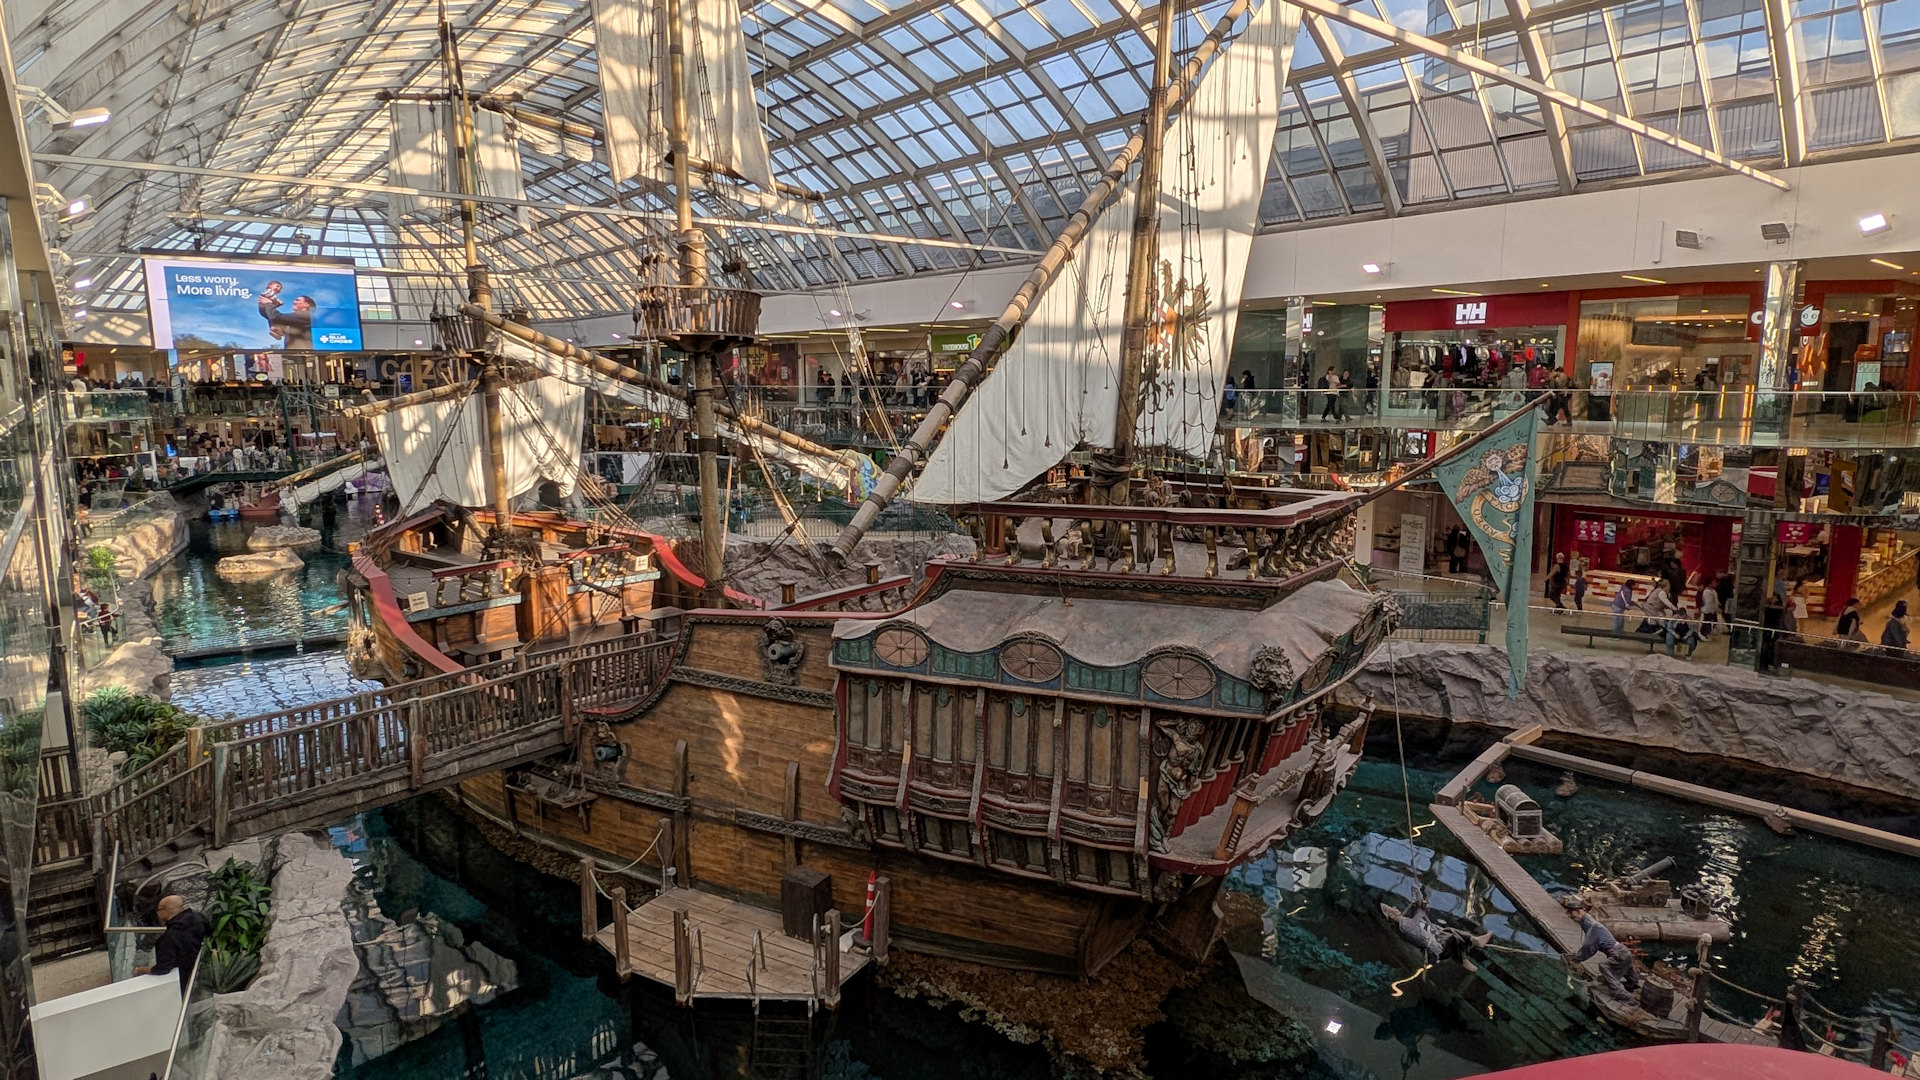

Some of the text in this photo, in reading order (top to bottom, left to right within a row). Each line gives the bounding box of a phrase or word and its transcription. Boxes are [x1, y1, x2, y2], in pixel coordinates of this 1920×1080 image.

[175, 273, 240, 287] Less worry.
[177, 284, 253, 299] More living.
[1455, 302, 1488, 320] HH
